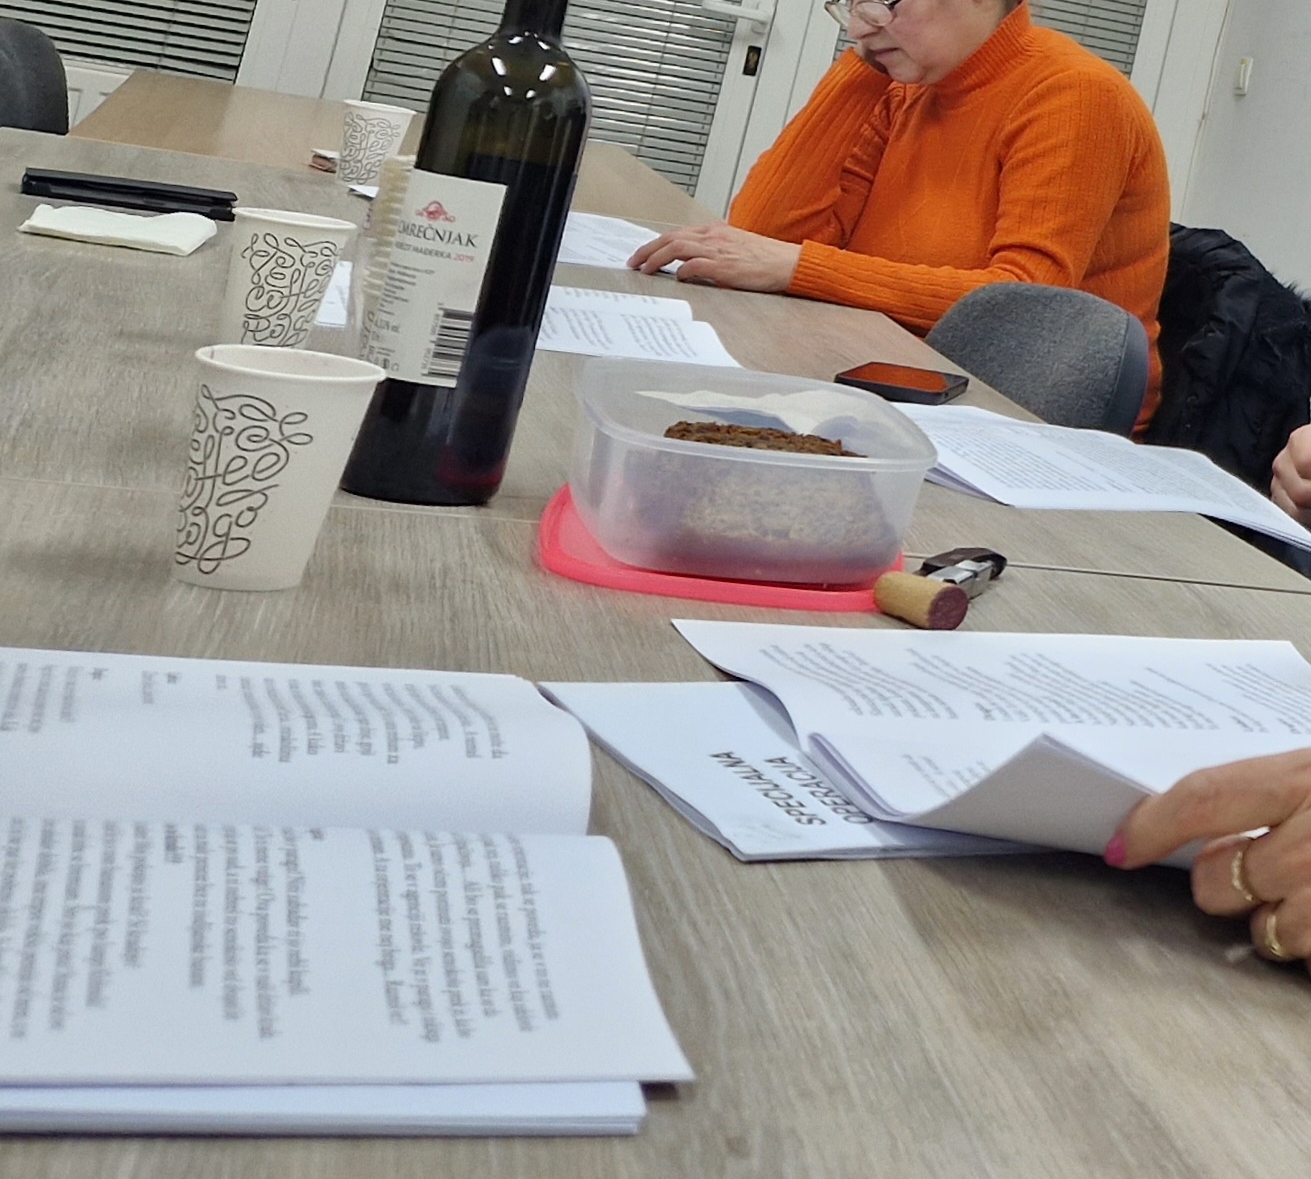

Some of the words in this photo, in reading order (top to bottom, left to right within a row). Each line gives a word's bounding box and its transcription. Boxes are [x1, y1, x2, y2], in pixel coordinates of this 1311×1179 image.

[453, 251, 476, 264] 2019
[707, 750, 827, 826] SPECIJALNA
[763, 756, 873, 825] OPERACIJA
